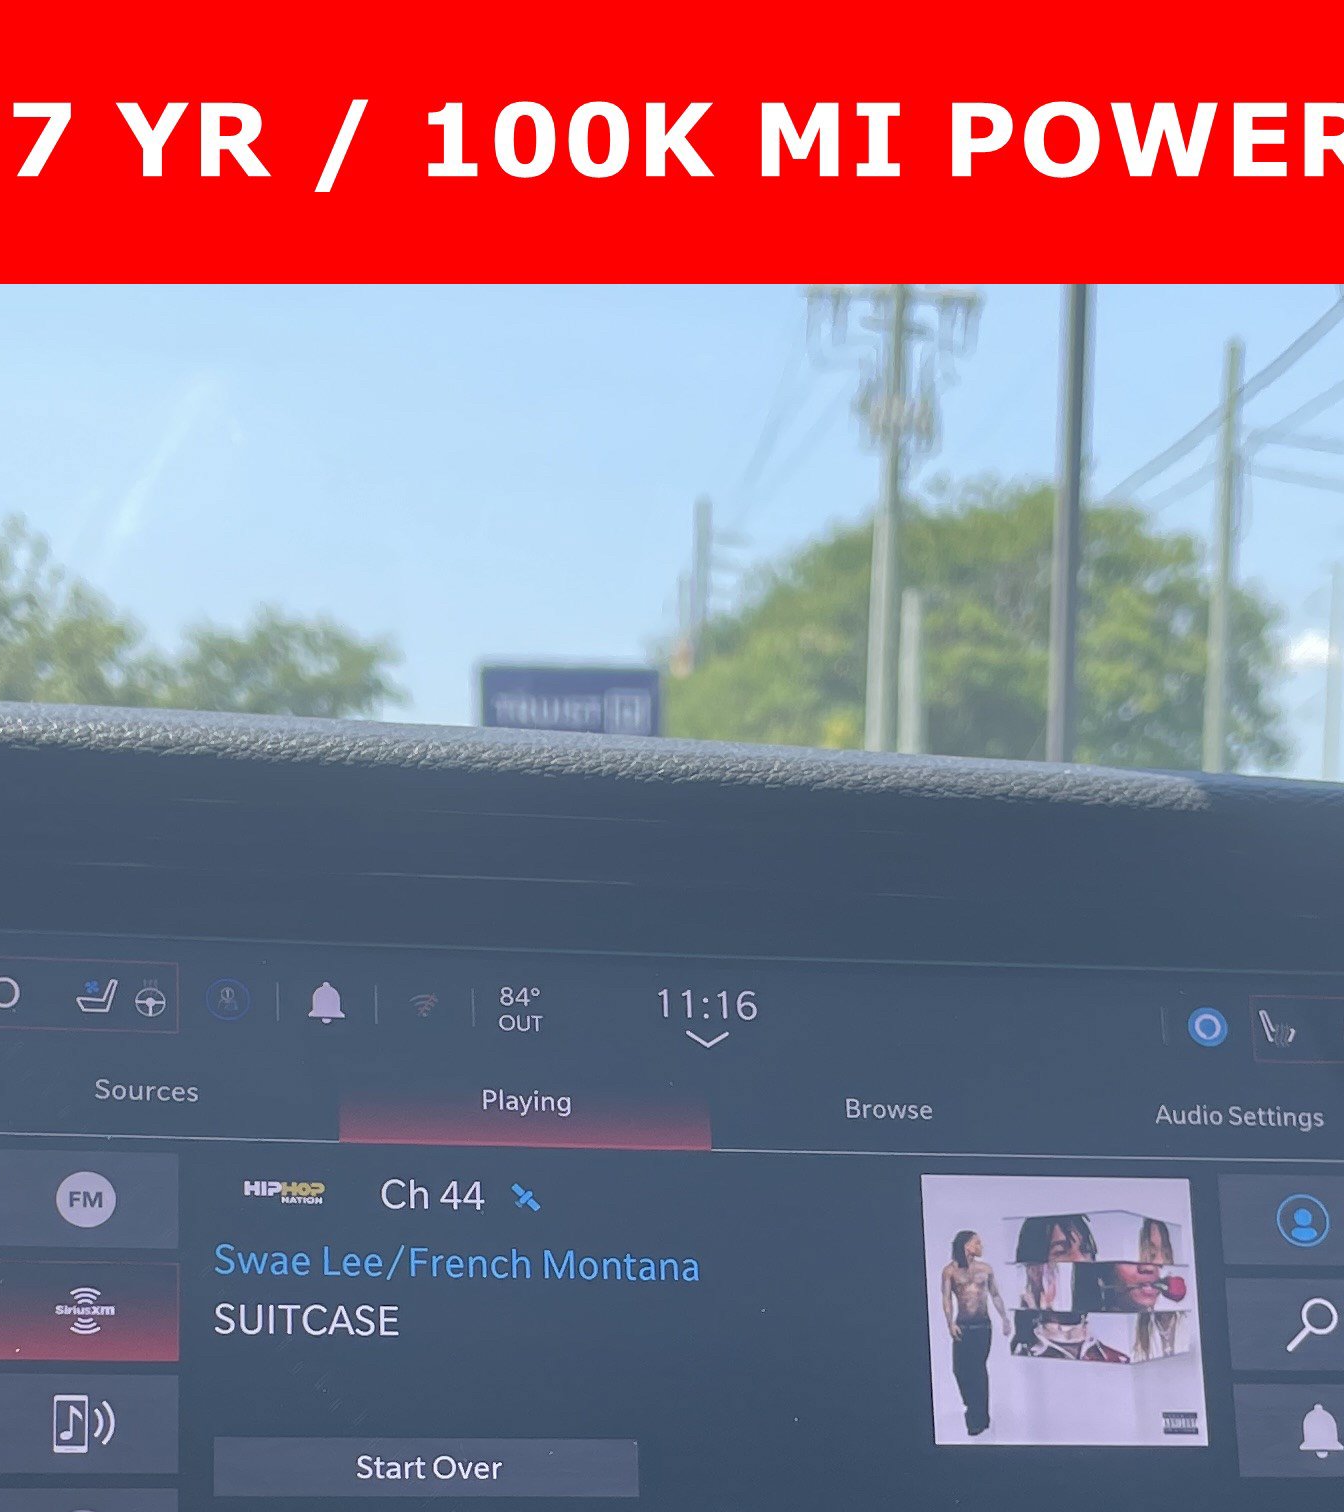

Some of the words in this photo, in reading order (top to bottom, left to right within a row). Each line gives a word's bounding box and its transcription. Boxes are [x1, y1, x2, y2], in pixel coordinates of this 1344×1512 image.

[498, 984, 542, 1008] 84°
[656, 986, 760, 1024] 11:16
[497, 1012, 544, 1033] OUT
[93, 1077, 200, 1104] Sources
[480, 1086, 574, 1118] Playing
[843, 1096, 935, 1123] Browse
[1153, 1102, 1225, 1128] Audio
[1227, 1104, 1326, 1132] Settings
[67, 1188, 105, 1210] FM
[280, 1195, 324, 1206] NATION
[380, 1178, 431, 1212] Ch
[438, 1178, 487, 1212] 44
[212, 1242, 312, 1280] Swae
[320, 1244, 532, 1284] Lee/French
[541, 1248, 702, 1286] Montana
[212, 1302, 401, 1340] SUITCASE
[355, 1453, 427, 1483] Start
[433, 1453, 504, 1483] Over
